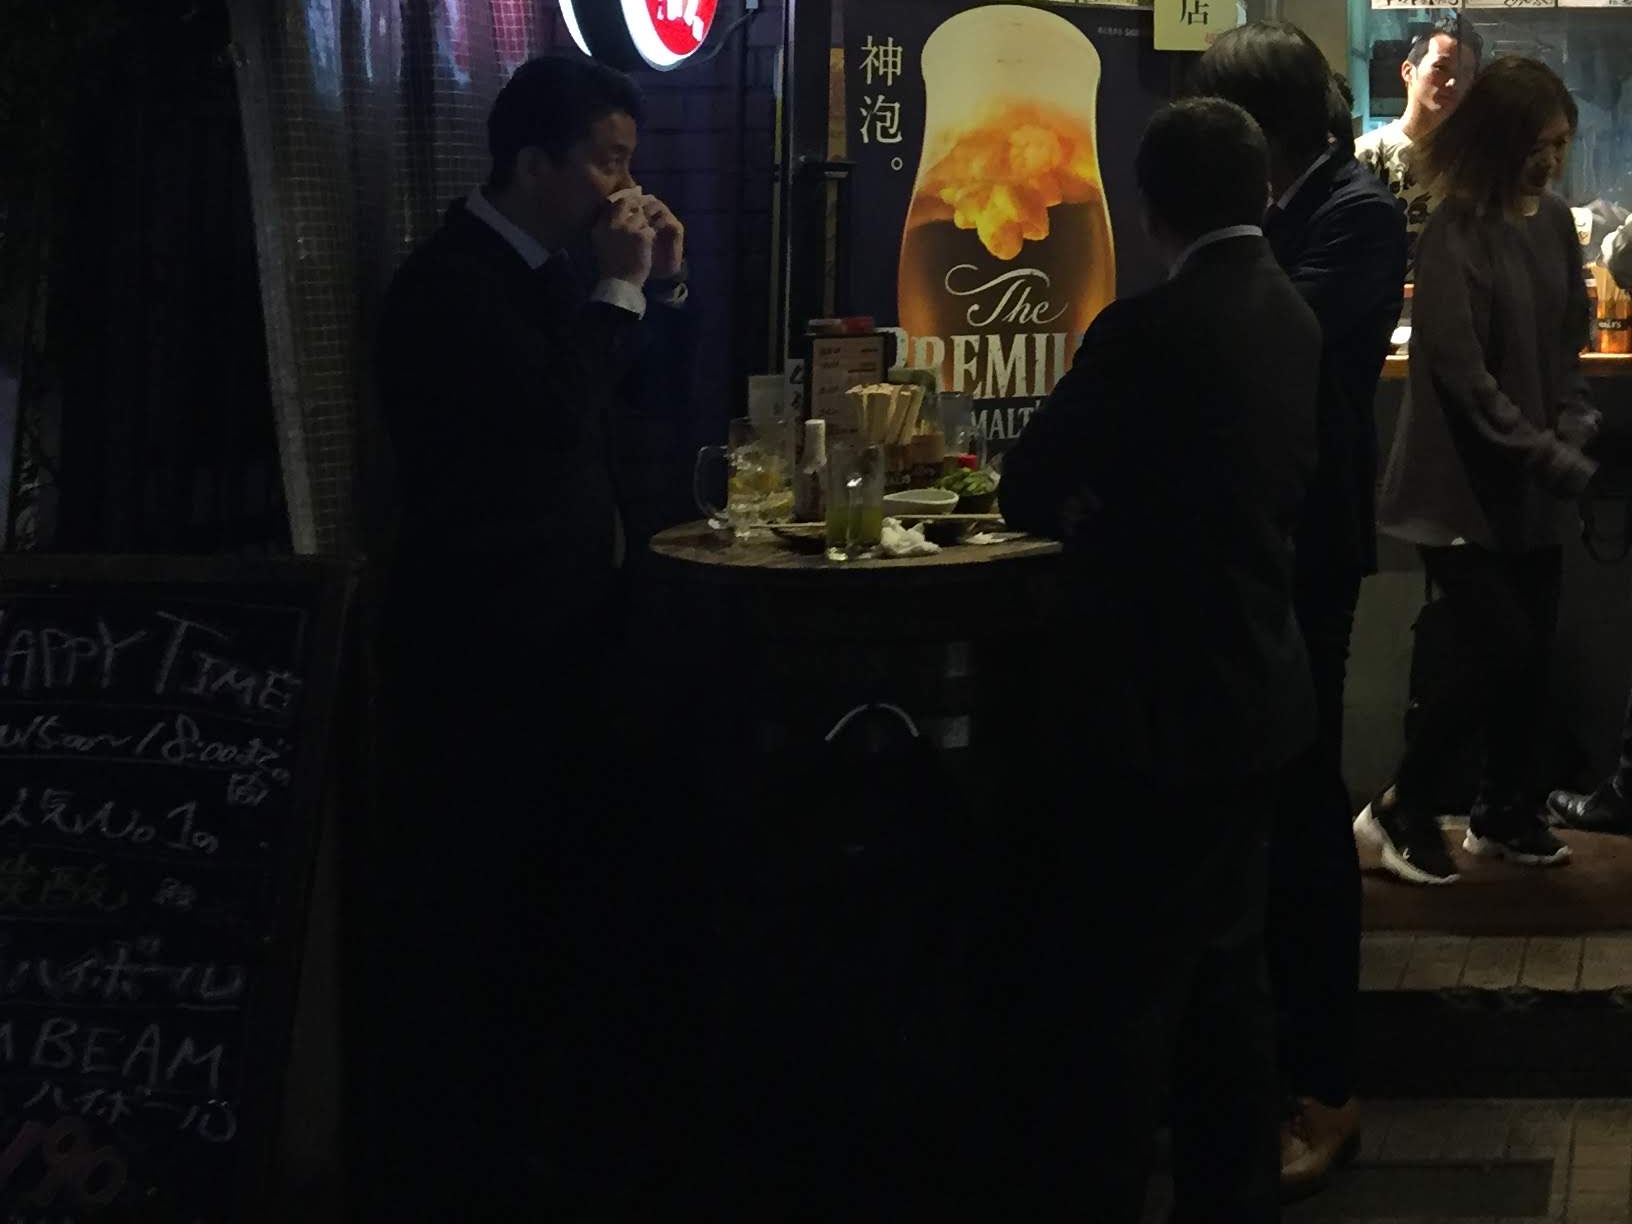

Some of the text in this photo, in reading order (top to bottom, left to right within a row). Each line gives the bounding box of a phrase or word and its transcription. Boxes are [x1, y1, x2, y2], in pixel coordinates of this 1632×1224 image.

[859, 34, 904, 171] 神泡。
[944, 263, 1069, 327] The
[0, 609, 304, 713] APPY TIME
[30, 1016, 225, 1094] BEAM
